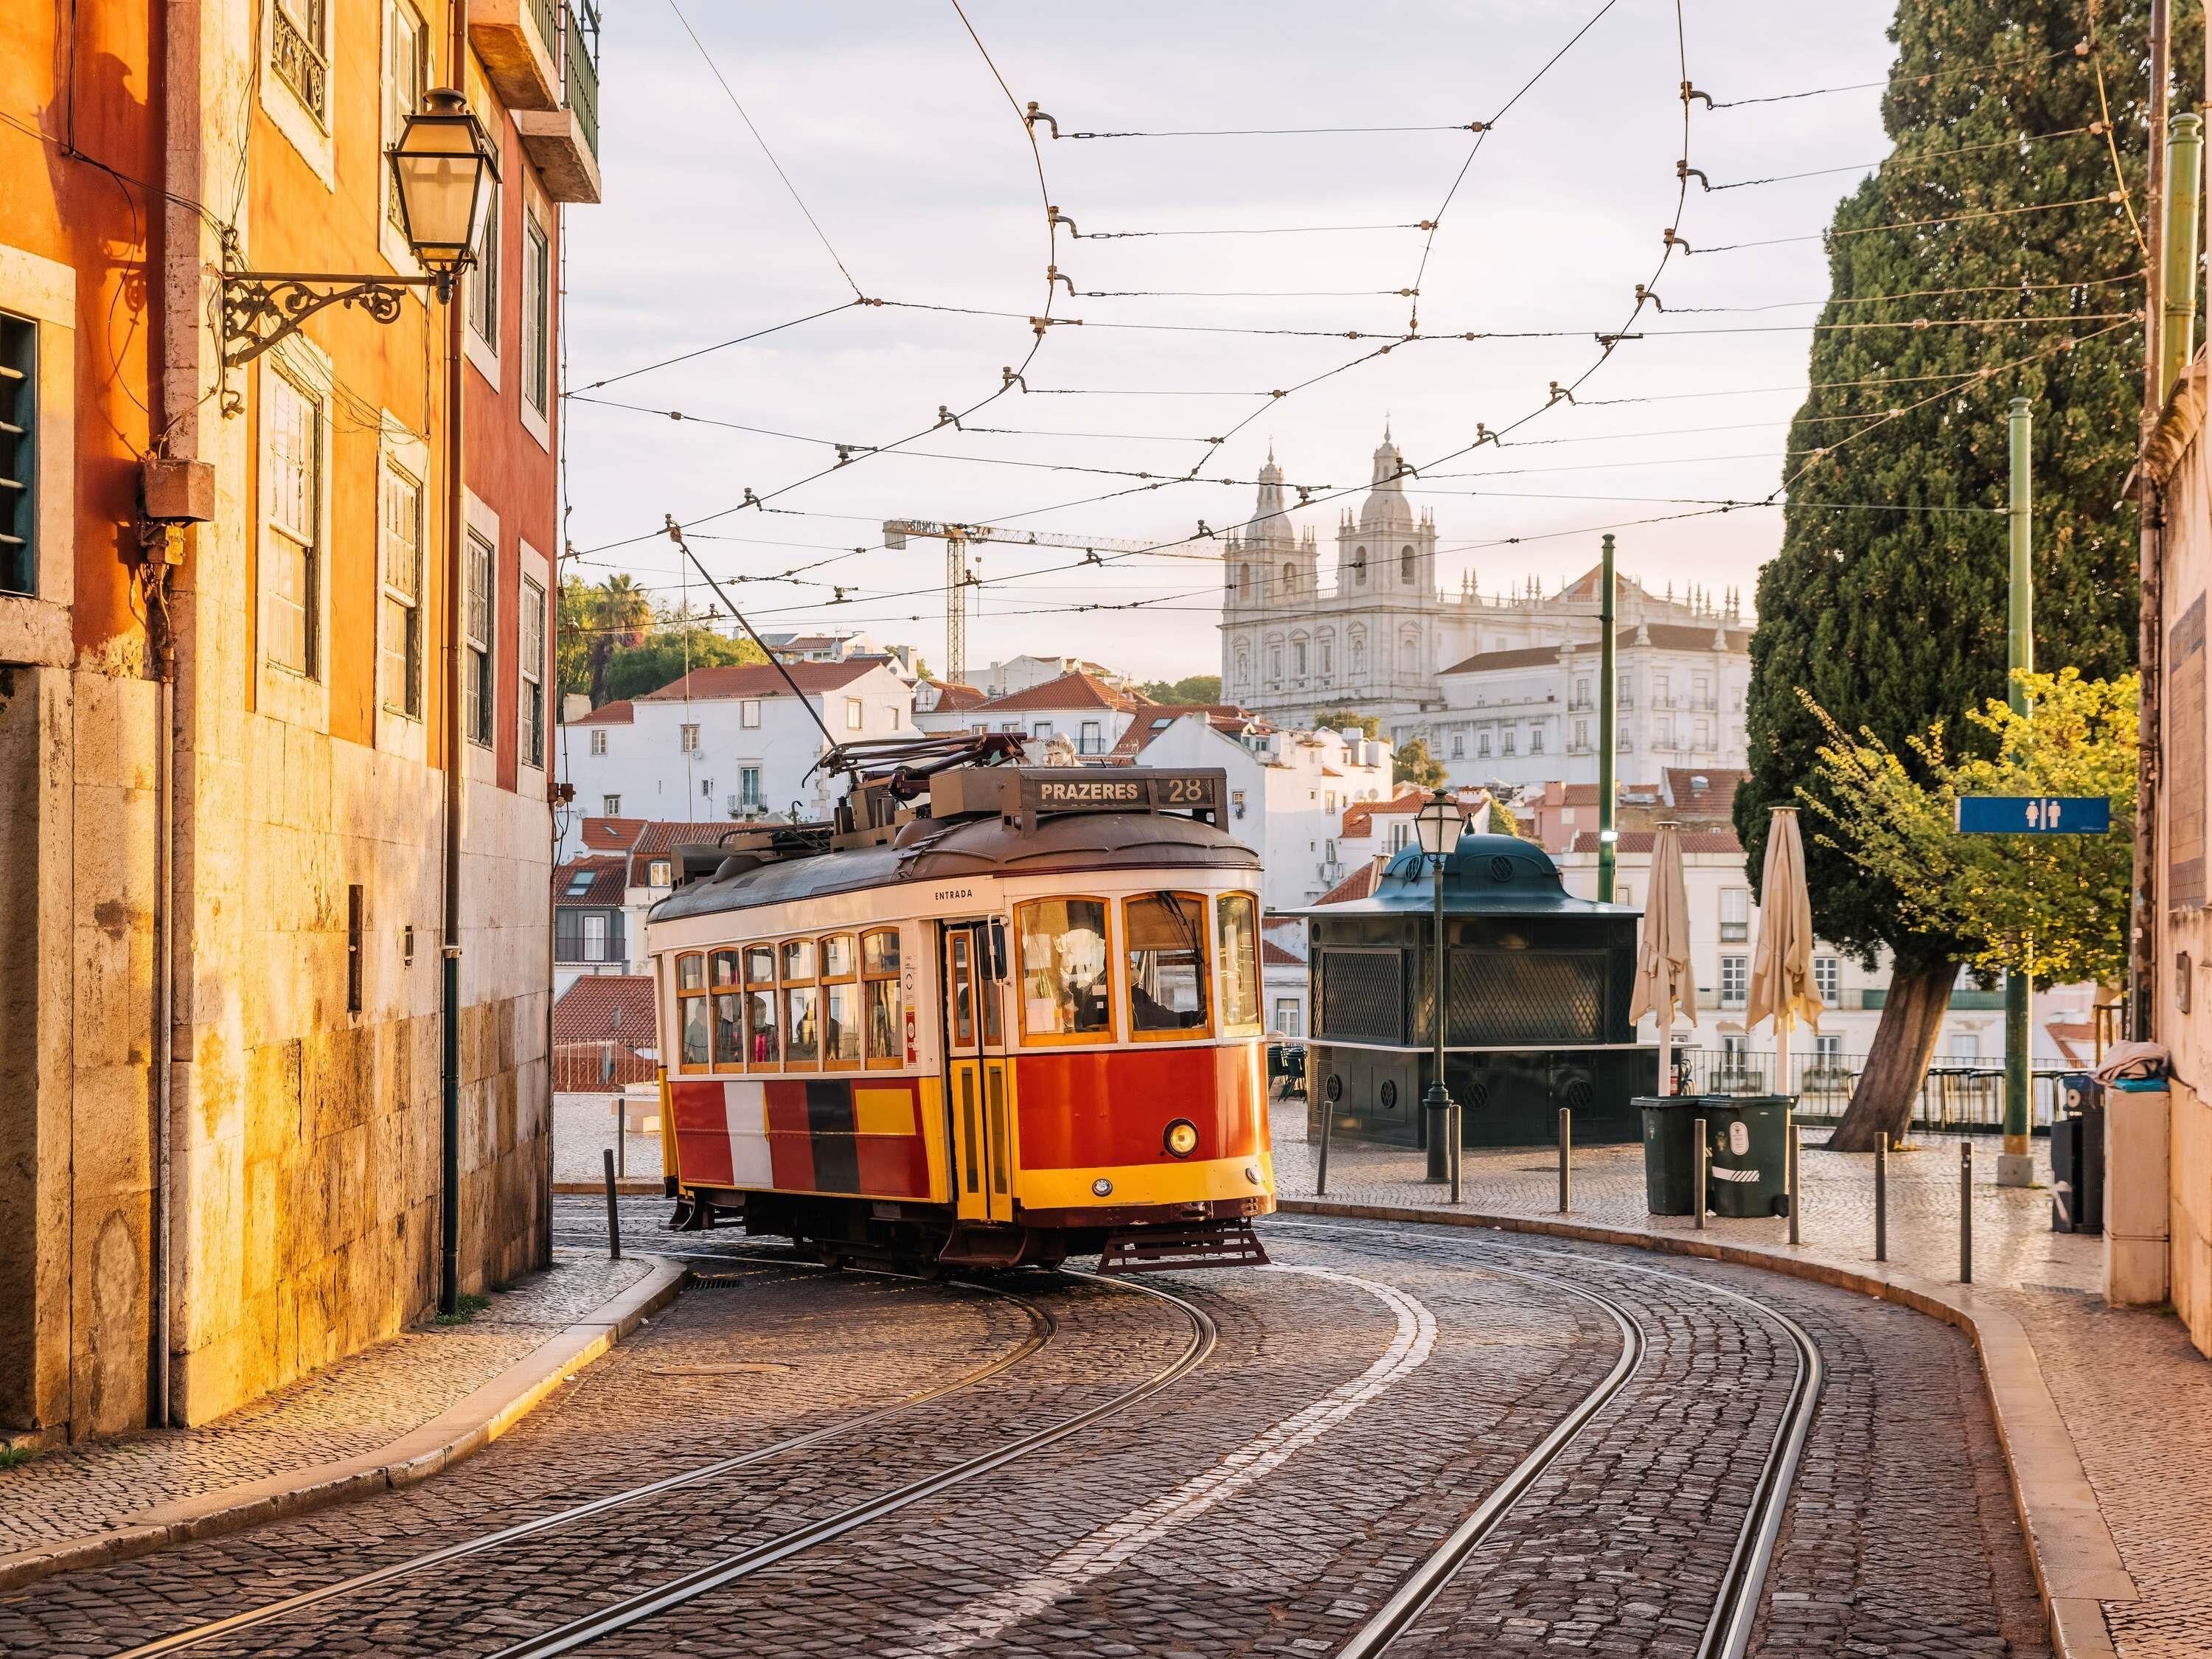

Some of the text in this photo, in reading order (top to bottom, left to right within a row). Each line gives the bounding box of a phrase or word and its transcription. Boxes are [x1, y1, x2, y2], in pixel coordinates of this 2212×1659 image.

[1042, 783, 1138, 800] PRAZERES
[1169, 779, 1202, 802] 28
[935, 889, 973, 900] ENTRADA
